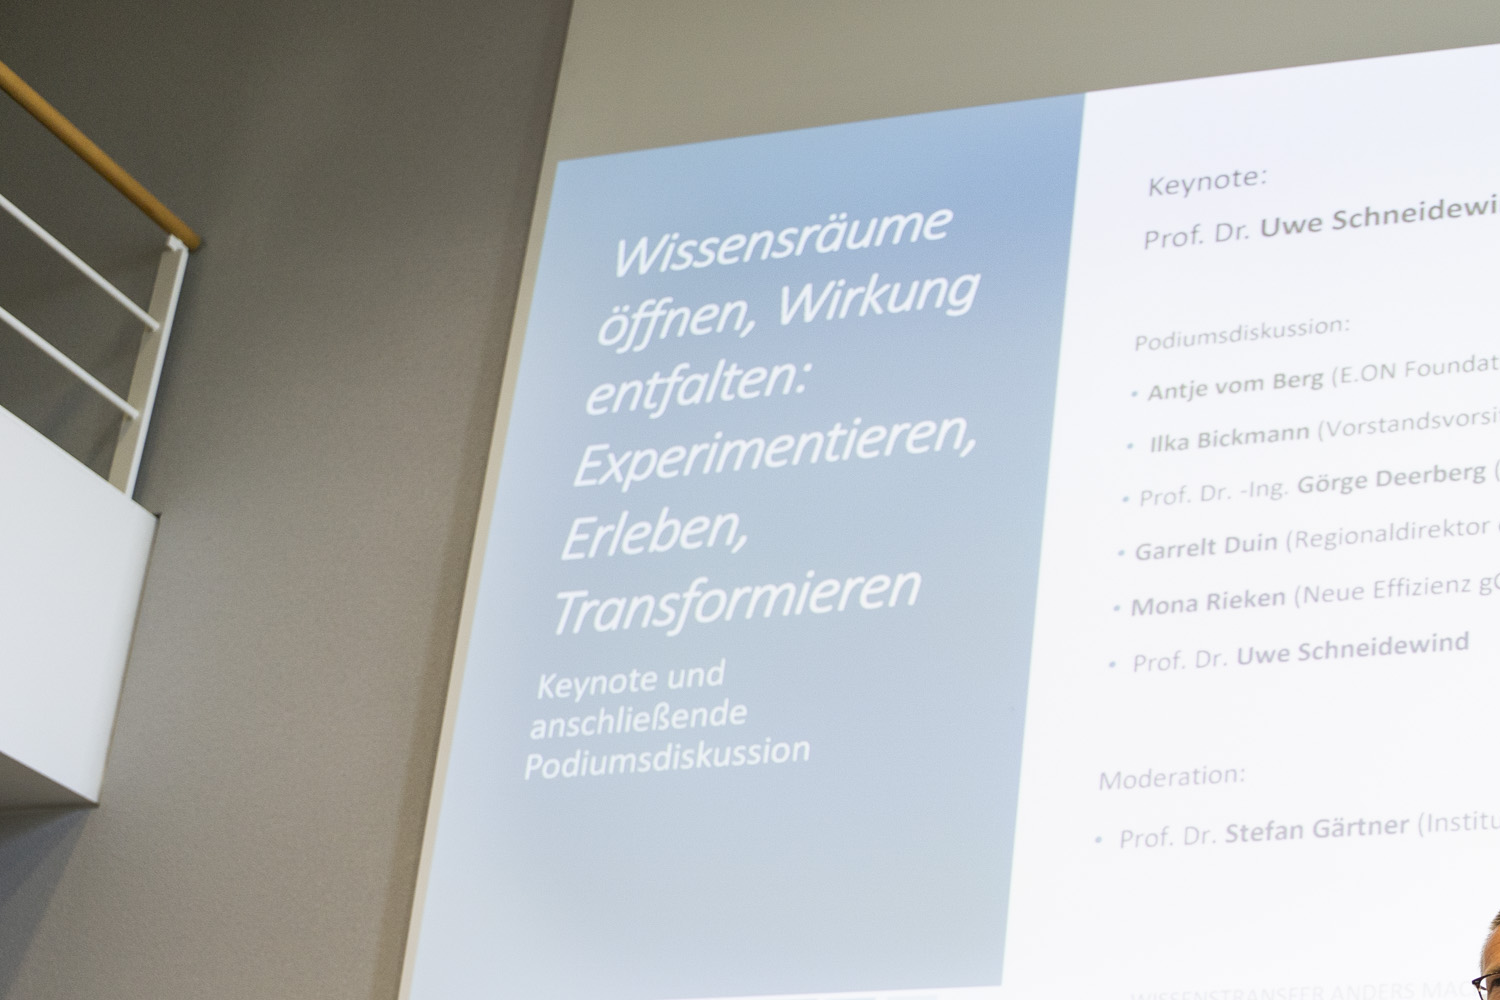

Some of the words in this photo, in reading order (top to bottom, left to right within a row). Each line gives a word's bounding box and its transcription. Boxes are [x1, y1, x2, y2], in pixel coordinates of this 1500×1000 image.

[1149, 170, 1266, 198] Keynote:
[617, 209, 953, 277] Wissensräume
[1145, 223, 1203, 250] Prof.
[1215, 223, 1249, 242] Dr.
[1261, 217, 1323, 237] Uwe
[599, 297, 755, 354] öffnen,
[781, 273, 981, 325] Wirkung
[1135, 319, 1349, 351] Podiumsdiskussion:
[587, 359, 812, 419] entfalten:
[1148, 380, 1208, 402] Antje
[1216, 378, 1264, 394] vom
[1273, 373, 1324, 390] Berg
[1332, 363, 1396, 388] (E.ON
[574, 417, 976, 492] Experimentieren,
[1151, 435, 1189, 452] Ilka
[1198, 427, 1309, 448] Bickmann
[1140, 485, 1191, 506] Prof.
[1201, 485, 1231, 502] Dr.
[1241, 481, 1288, 501] -Ing.
[1298, 474, 1368, 495] Görge
[1376, 465, 1486, 487] Deerberg
[562, 507, 747, 560] Erleben,
[1135, 538, 1216, 561] Garrelt
[1225, 533, 1277, 554] Duin
[1286, 519, 1490, 553] (Regionaldirektor
[556, 570, 922, 637] Transformieren
[1132, 598, 1198, 616] Mona
[1207, 590, 1285, 610] Rieken
[1295, 586, 1364, 608] (Neue
[1374, 577, 1471, 599] Effizienz
[1134, 650, 1185, 672] Prof.
[1196, 650, 1227, 668] Dr.
[1238, 647, 1290, 665] Uwe
[1298, 631, 1469, 661] Schneidewind
[538, 669, 658, 702] Keynote
[668, 658, 726, 689] und
[530, 698, 747, 739] anschließende
[525, 737, 810, 780] Podiumsdiskussion
[1099, 766, 1245, 790] Moderation:
[1120, 826, 1173, 848] Prof.
[1184, 826, 1216, 846] Dr.
[1226, 820, 1303, 843] Stefan
[1313, 818, 1410, 838] Gärtner
[1331, 983, 1414, 1000] ANDERS
